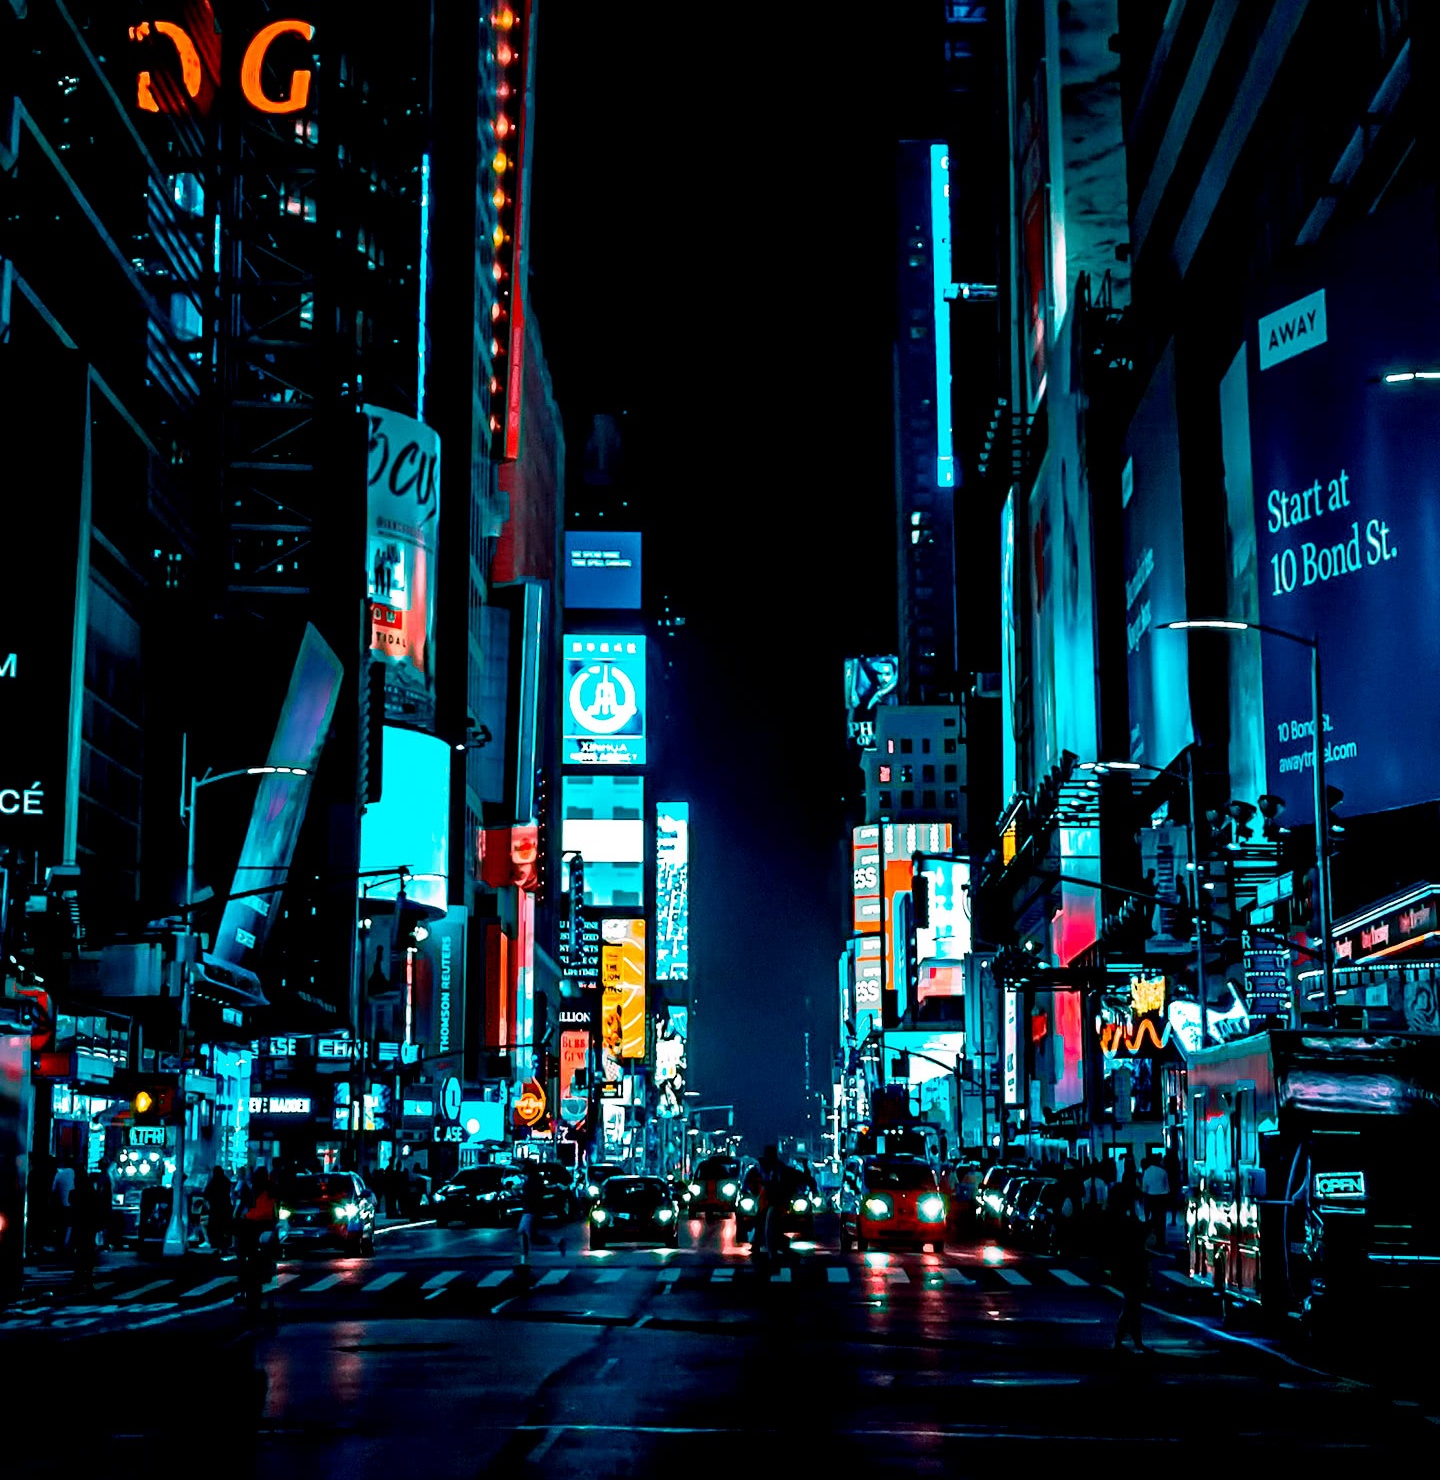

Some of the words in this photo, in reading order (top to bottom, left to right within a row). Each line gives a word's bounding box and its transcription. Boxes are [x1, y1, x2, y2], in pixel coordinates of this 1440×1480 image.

[1268, 308, 1317, 352] AWAY
[1268, 481, 1322, 534] Start
[1328, 469, 1350, 512] at
[1271, 547, 1297, 597] 10
[1301, 522, 1362, 588] Bond
[1366, 517, 1398, 567] St.
[1277, 722, 1289, 742] 10
[440, 936, 451, 991] REUTERS
[440, 992, 451, 1053] THOMSON
[434, 1126, 463, 1142] CASE
[1320, 1178, 1361, 1193] OPEN
